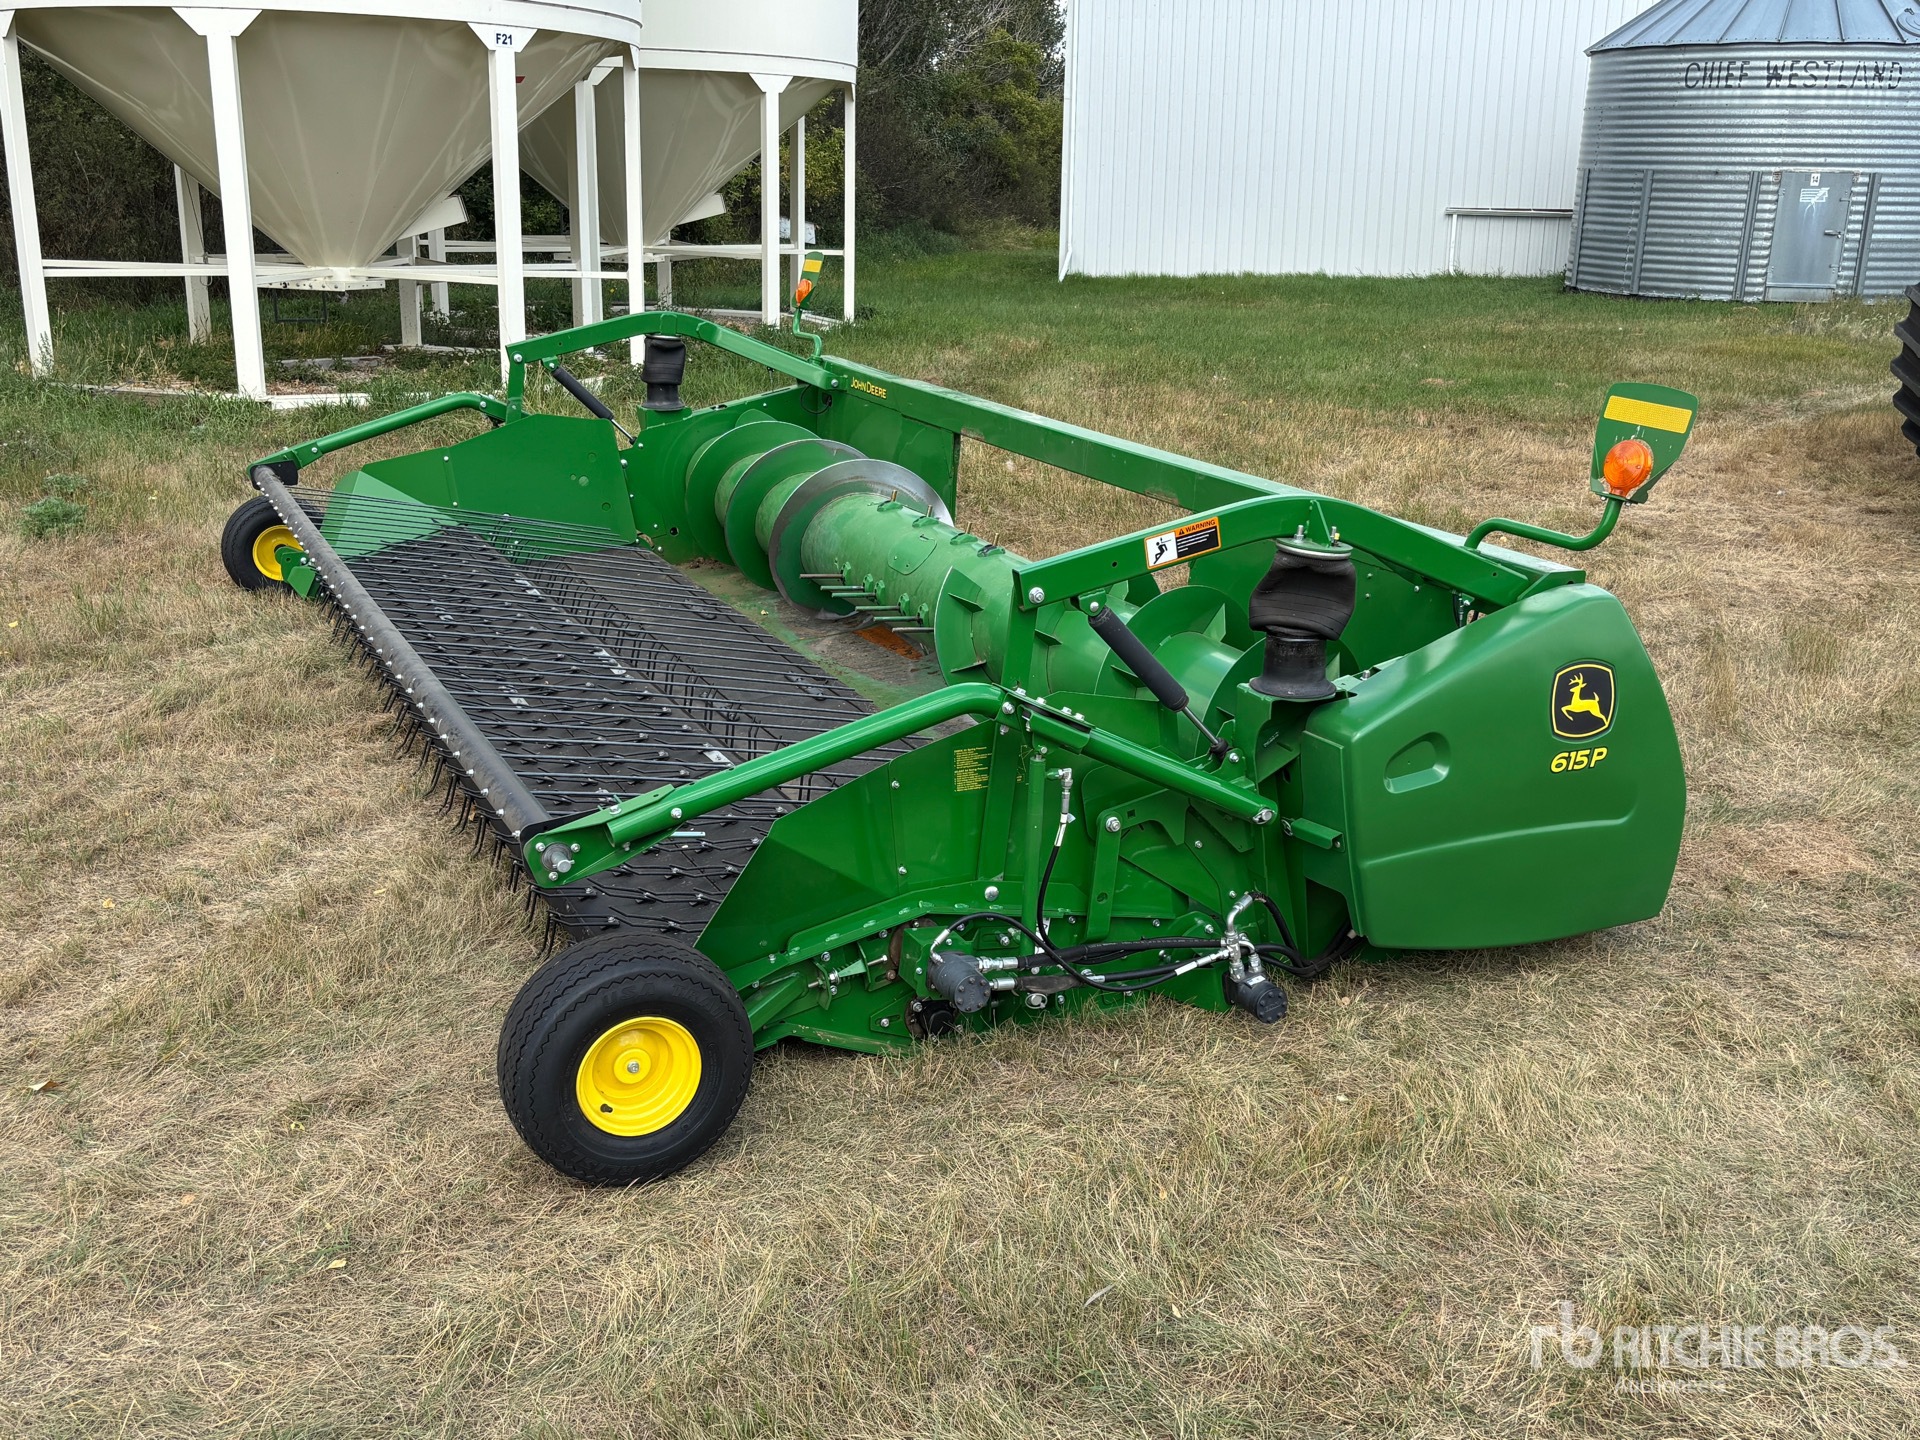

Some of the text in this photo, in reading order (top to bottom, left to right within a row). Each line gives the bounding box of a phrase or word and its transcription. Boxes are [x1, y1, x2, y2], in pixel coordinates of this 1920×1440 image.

[495, 32, 513, 46] F21
[1684, 59, 1903, 90] CHIEF WESTLAND
[851, 376, 887, 399] JOHN DEERE
[1185, 519, 1216, 533] WARNING
[1550, 747, 1608, 773] 615P
